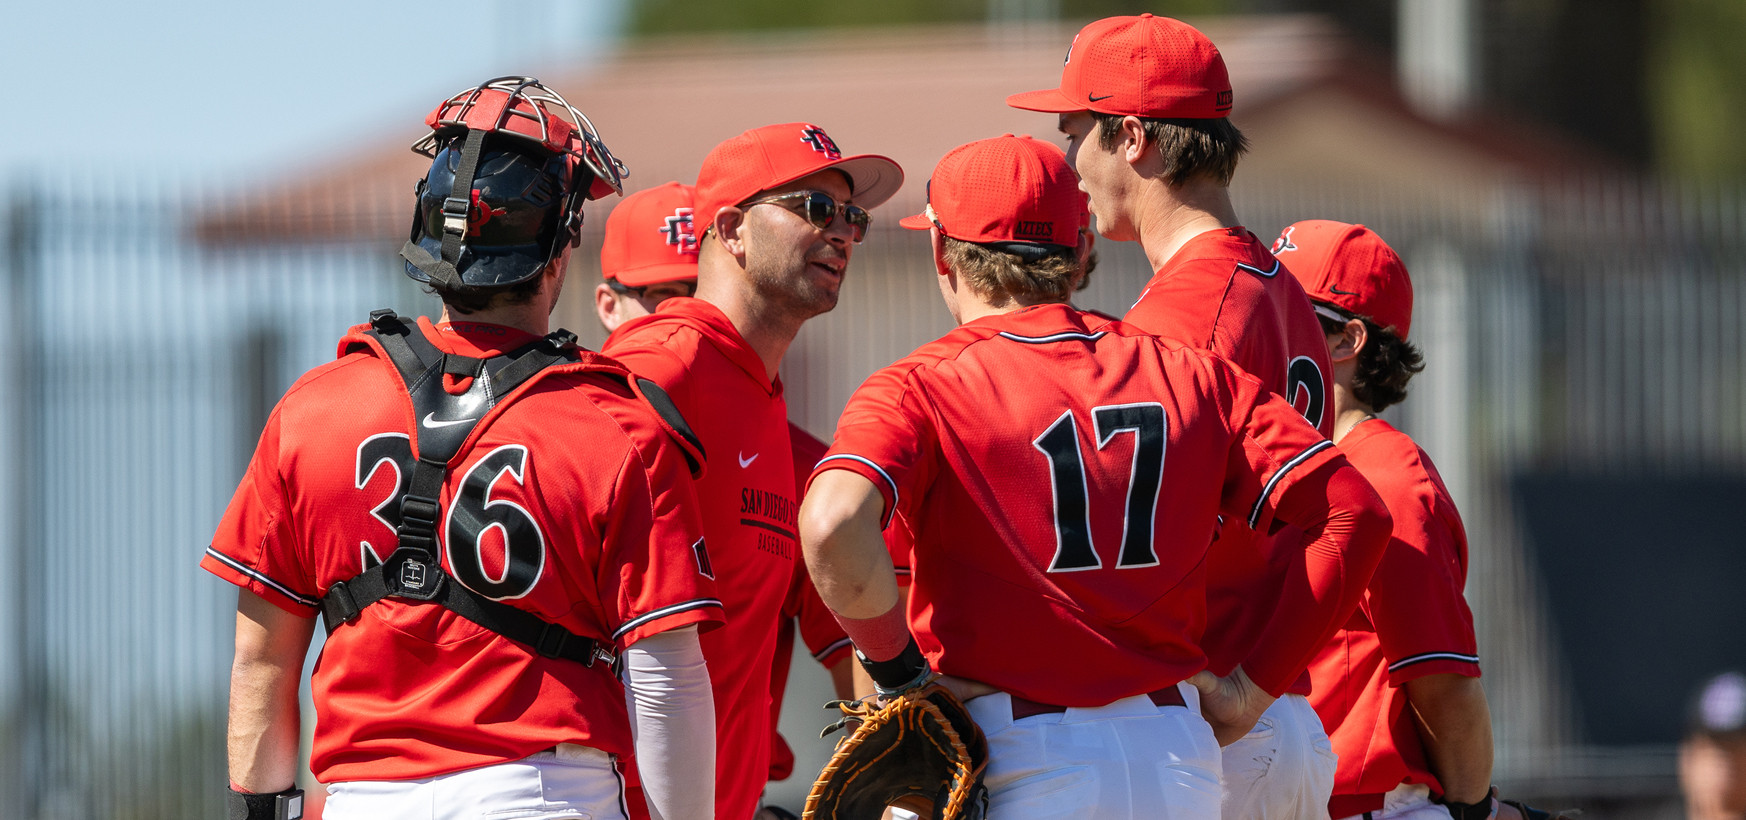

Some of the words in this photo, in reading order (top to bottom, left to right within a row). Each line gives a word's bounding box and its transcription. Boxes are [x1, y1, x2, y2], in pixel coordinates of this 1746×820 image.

[1015, 220, 1054, 237] AZTECS
[474, 325, 506, 336] PRO
[1033, 401, 1167, 573] 17
[355, 432, 546, 602] 36
[741, 488, 762, 514] SAN
[763, 491, 788, 523] DIEGO
[758, 533, 792, 560] BASEBALL
